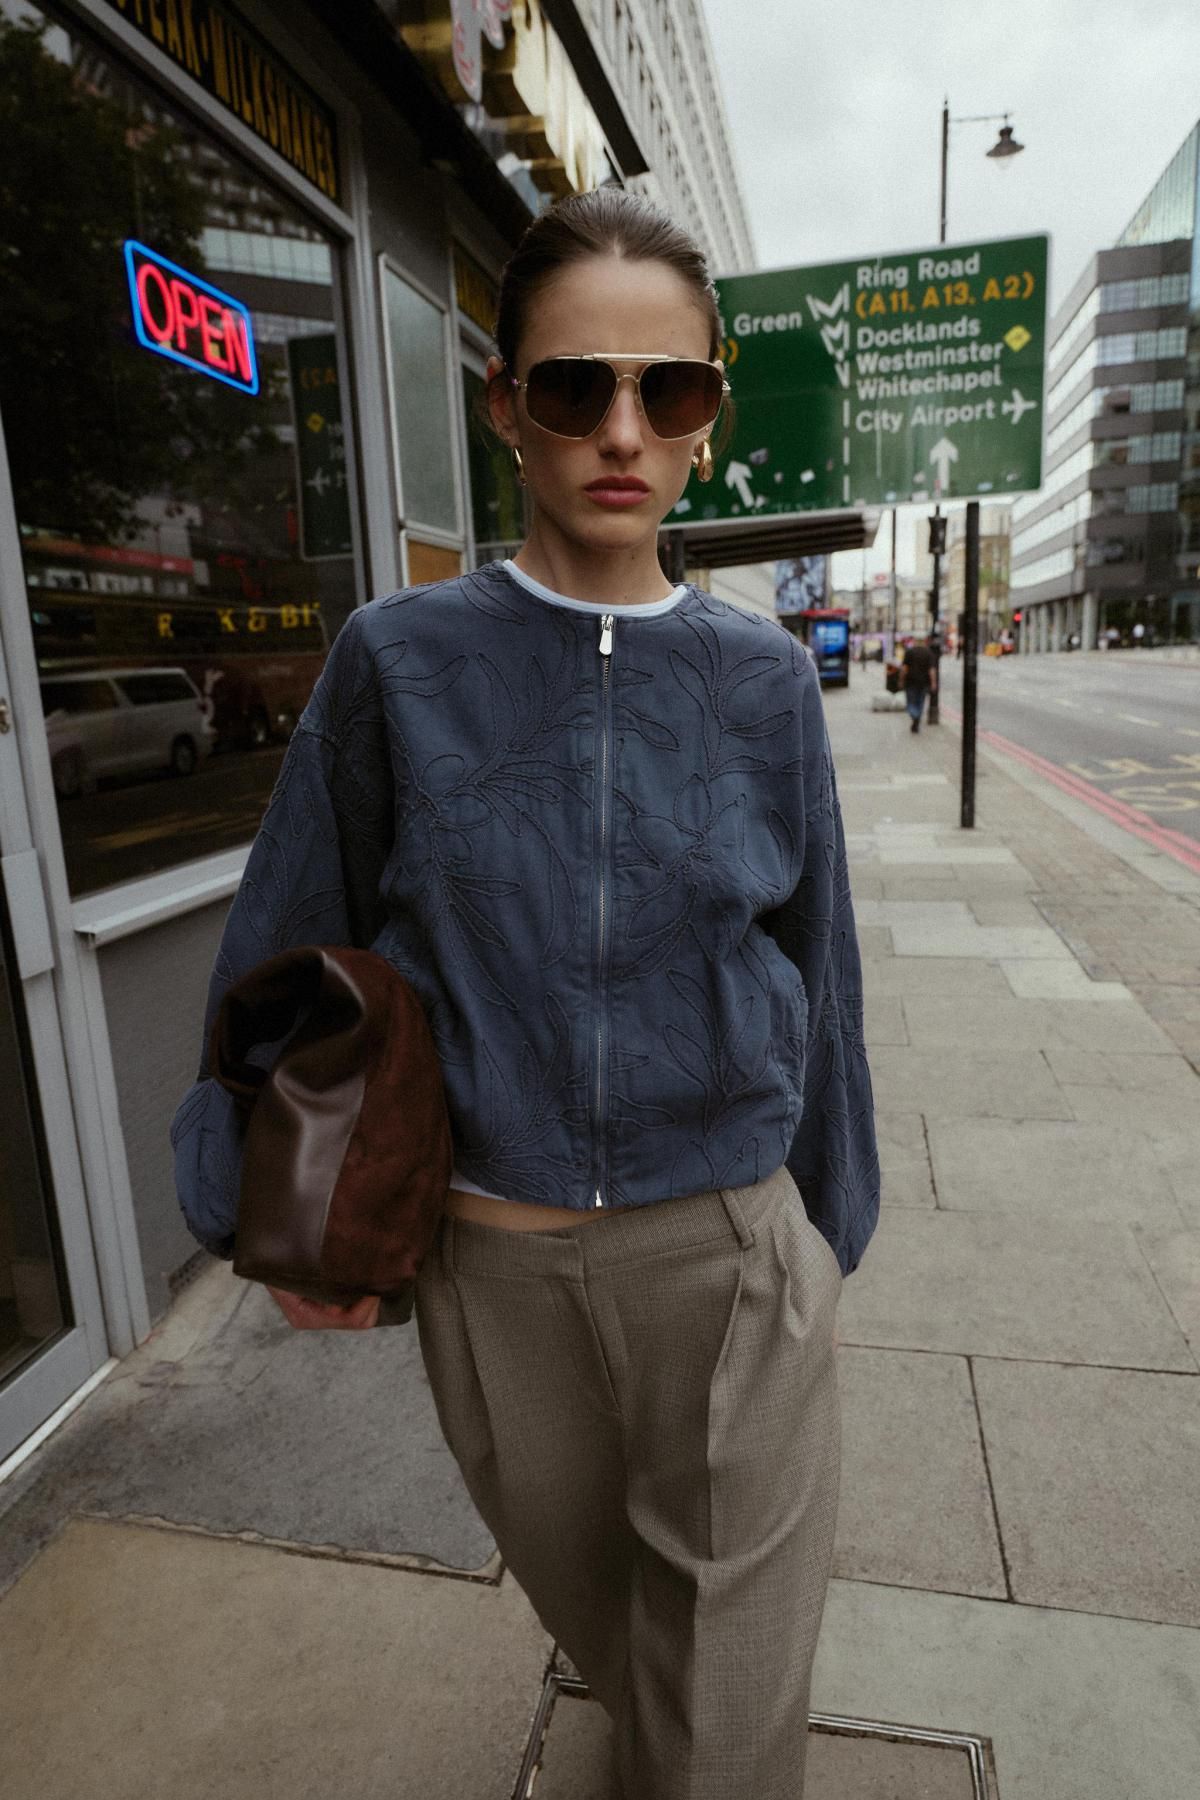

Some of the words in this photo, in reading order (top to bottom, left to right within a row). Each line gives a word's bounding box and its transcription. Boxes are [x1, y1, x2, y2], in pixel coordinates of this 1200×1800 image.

[857, 264, 909, 289] Ring
[918, 251, 981, 282] Road
[982, 271, 1035, 301] A2)
[136, 263, 253, 382] OPEN
[733, 312, 803, 337] Green
[857, 315, 981, 350] Docklands
[856, 341, 1004, 375] Westminster
[856, 364, 1003, 401] Whitechapel
[856, 409, 903, 434] City
[910, 397, 996, 428] Airport
